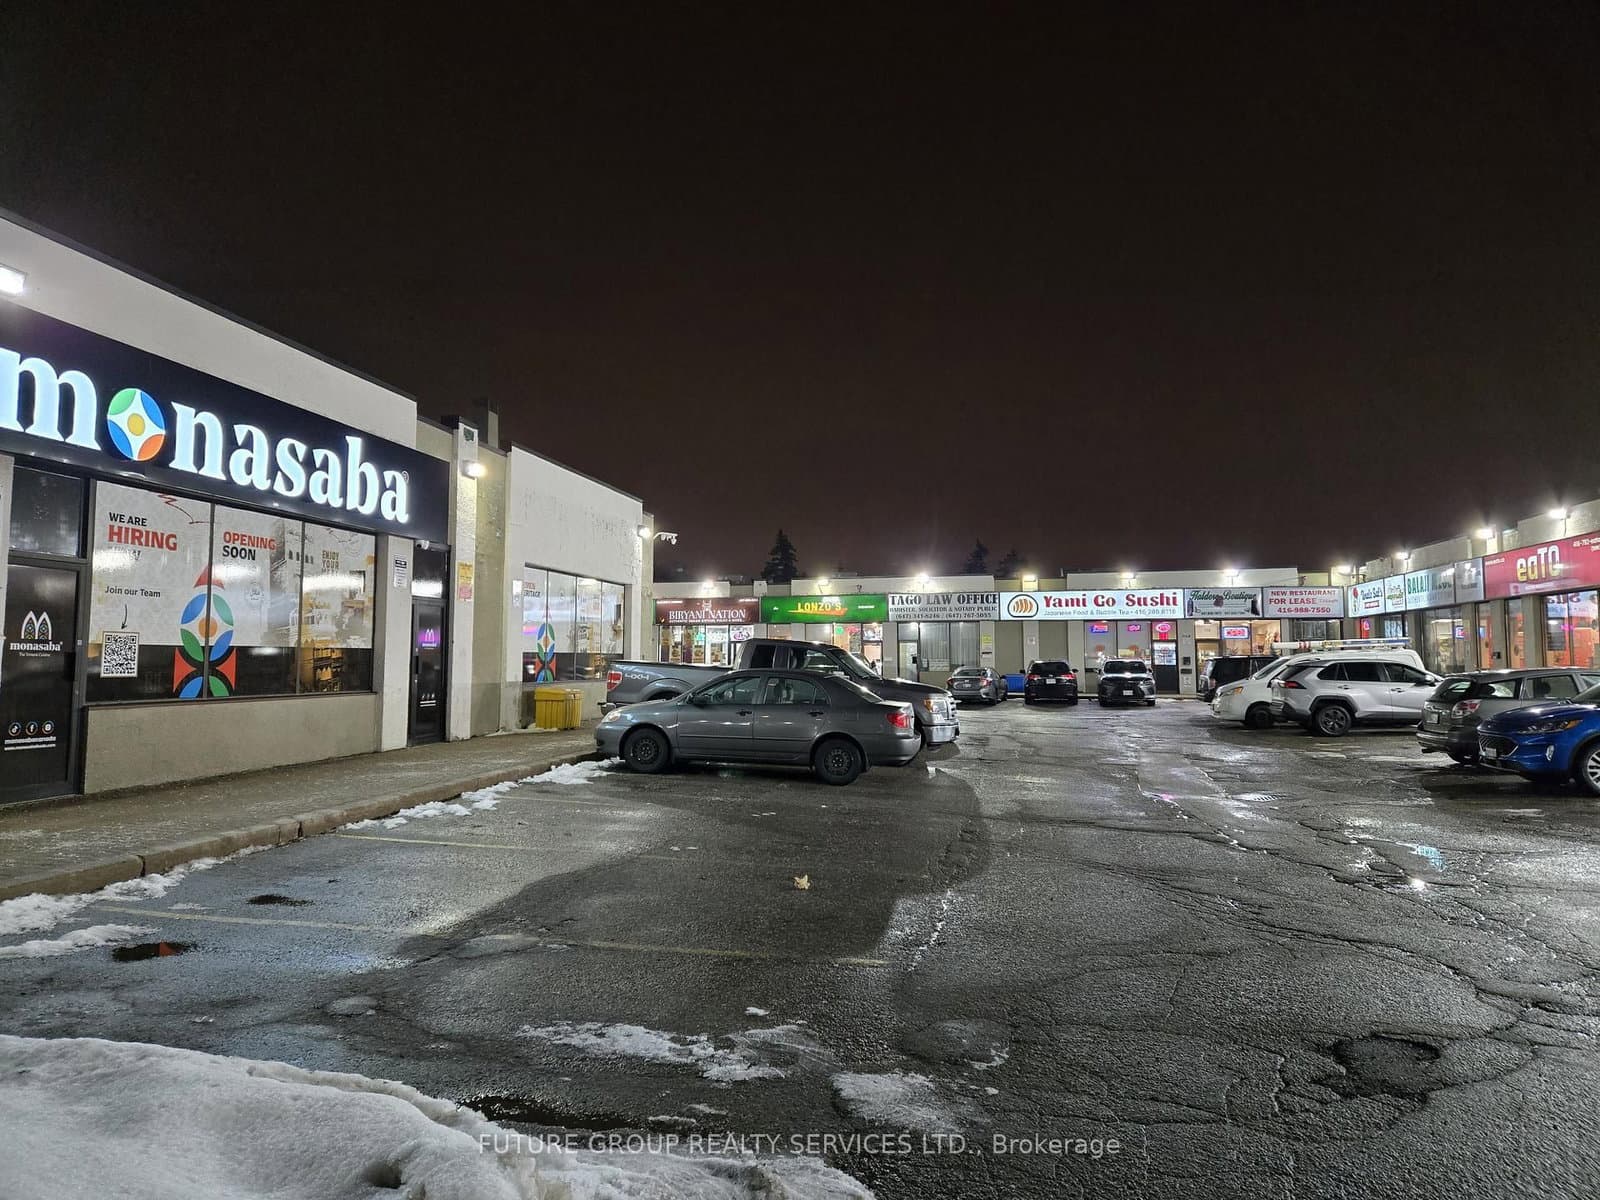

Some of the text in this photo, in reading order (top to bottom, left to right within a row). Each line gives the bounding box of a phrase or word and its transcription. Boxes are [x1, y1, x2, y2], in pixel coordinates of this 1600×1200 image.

[109, 512, 147, 527] WE ARE
[108, 524, 177, 551] HIRING
[223, 531, 276, 550] OPENING
[222, 545, 256, 561] SOON
[105, 586, 123, 594] Join
[140, 589, 161, 598] Team
[890, 593, 998, 605] TAGO LAW OFFICE
[1043, 592, 1179, 608] Yami Go Sushi
[708, 608, 746, 619] NATION
[9, 641, 61, 651] monasaba
